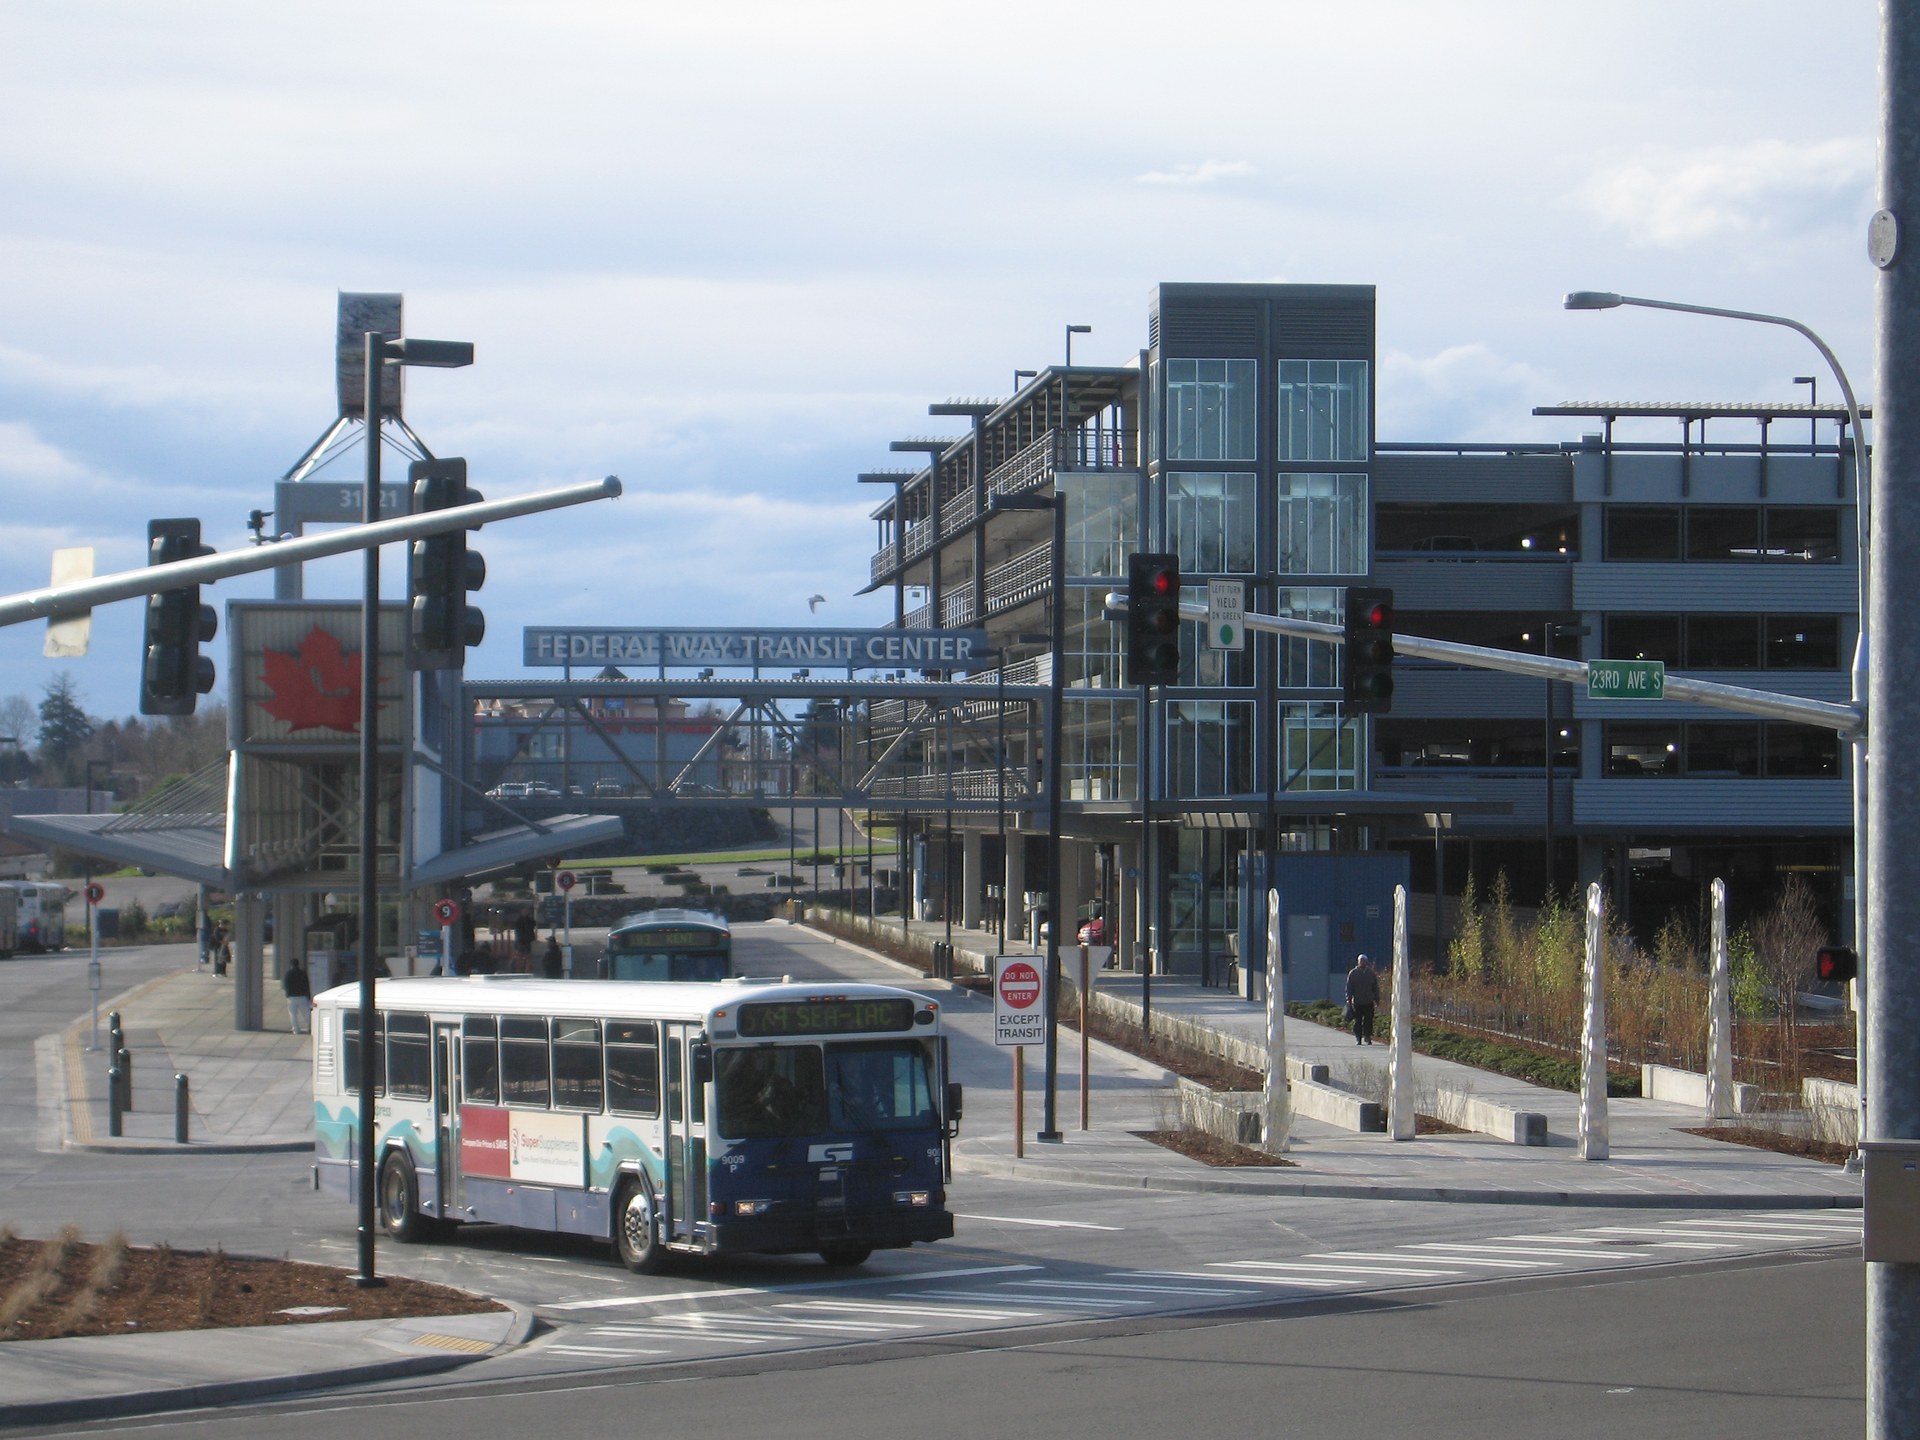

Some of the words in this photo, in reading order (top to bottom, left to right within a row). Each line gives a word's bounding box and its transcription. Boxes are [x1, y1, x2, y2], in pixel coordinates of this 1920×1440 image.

[339, 489, 397, 508] 3121
[1212, 585, 1224, 593] LEFT
[1227, 585, 1241, 594] TURN
[1216, 597, 1237, 609] YIELD
[1212, 612, 1220, 620] ON
[1223, 612, 1241, 621] GREEN
[537, 634, 659, 659] FEDERAL
[668, 634, 734, 659] WAY
[741, 635, 856, 660] TRANSIT
[866, 636, 973, 661] CENTER
[1591, 670, 1620, 689] 23RD
[1627, 670, 1647, 689] AVE
[1653, 671, 1661, 690] S
[441, 905, 451, 918] 9
[1005, 972, 1016, 980] DO
[1019, 971, 1035, 980] NOT
[1007, 992, 1032, 1001] ENTER
[797, 1002, 893, 1028] SEA-TAC
[999, 1014, 1041, 1025] EXCEPT
[997, 1027, 1043, 1039] TRANSIT
[721, 1154, 745, 1165] 9009
[934, 1156, 941, 1166] P
[730, 1164, 737, 1173] P
